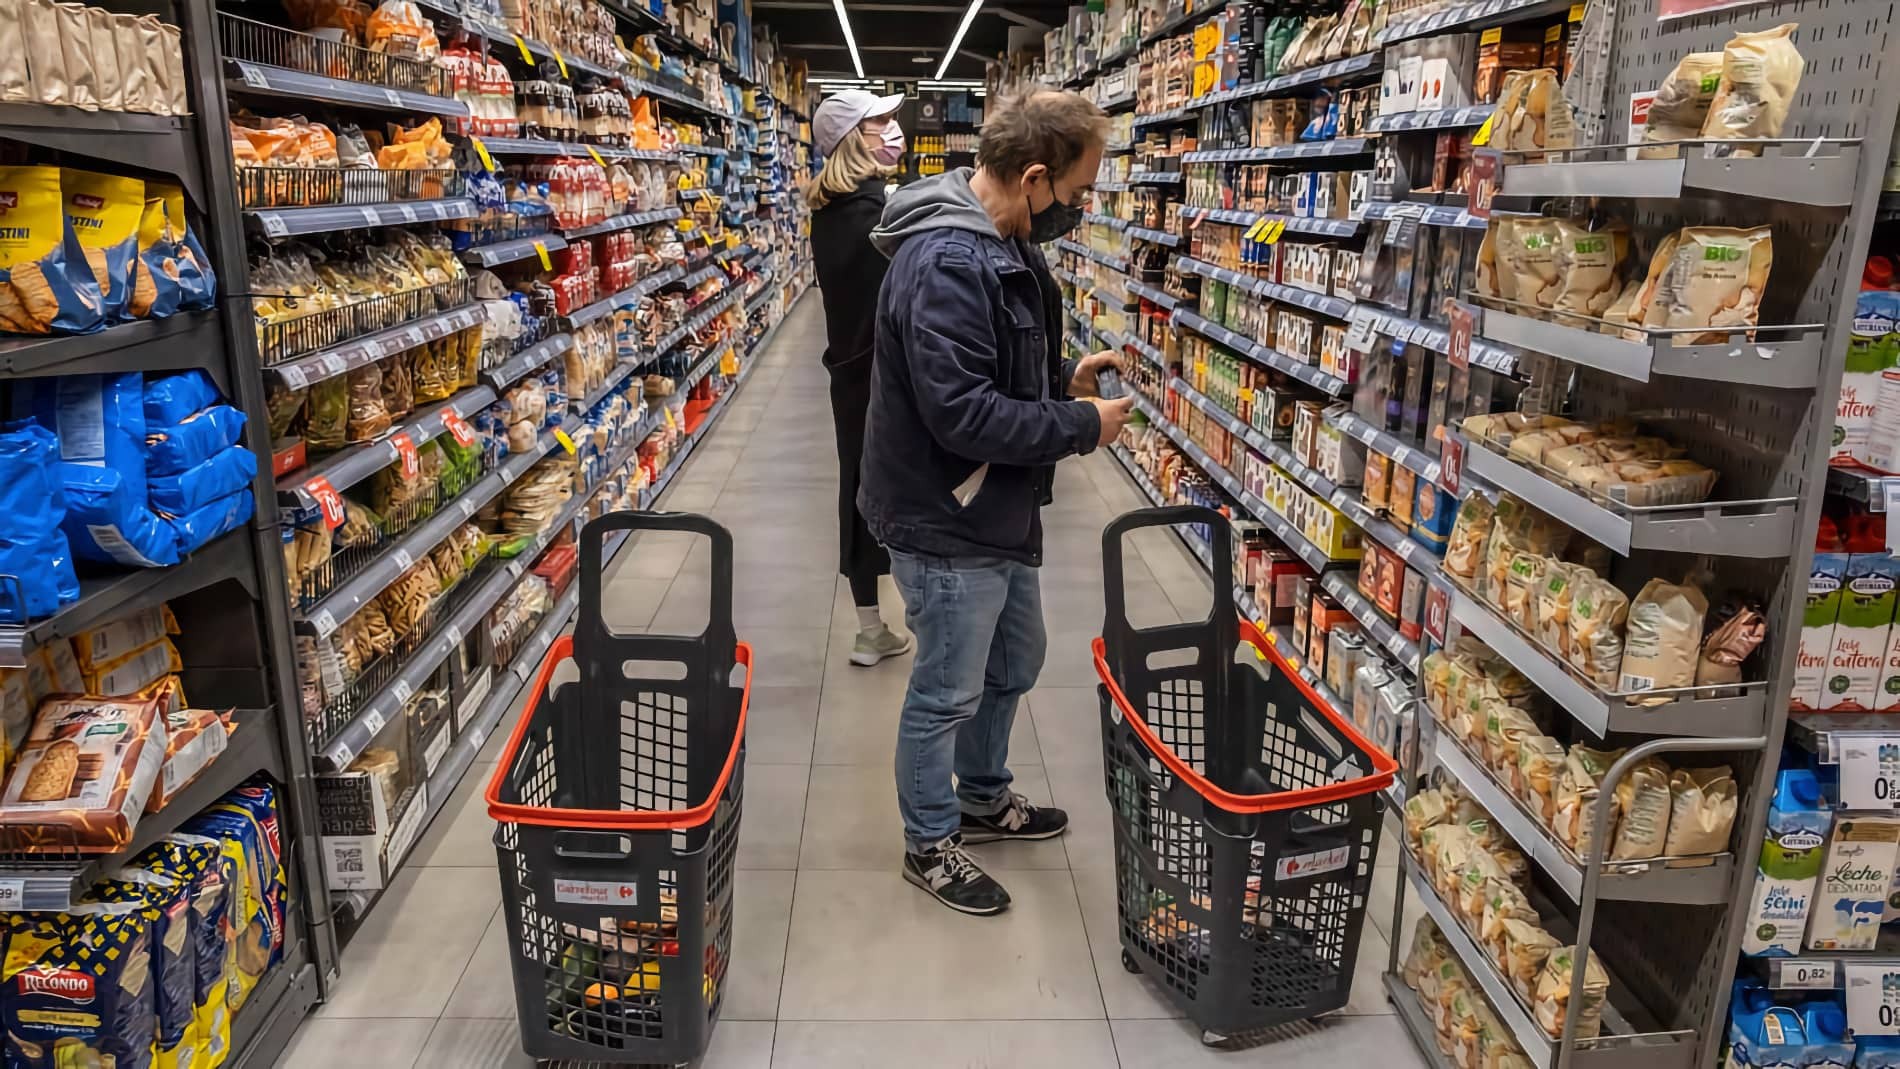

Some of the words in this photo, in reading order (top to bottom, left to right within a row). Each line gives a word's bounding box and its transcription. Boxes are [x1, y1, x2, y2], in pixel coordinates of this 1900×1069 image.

[1700, 73, 1720, 93] BI
[1704, 246, 1743, 262] BIO
[1833, 650, 1881, 669] entera
[1874, 777, 1889, 800] 0
[1826, 861, 1882, 883] Leche
[1827, 883, 1882, 894] DESNATADA
[1763, 895, 1806, 910] semi
[1878, 1004, 1892, 1026] 0
